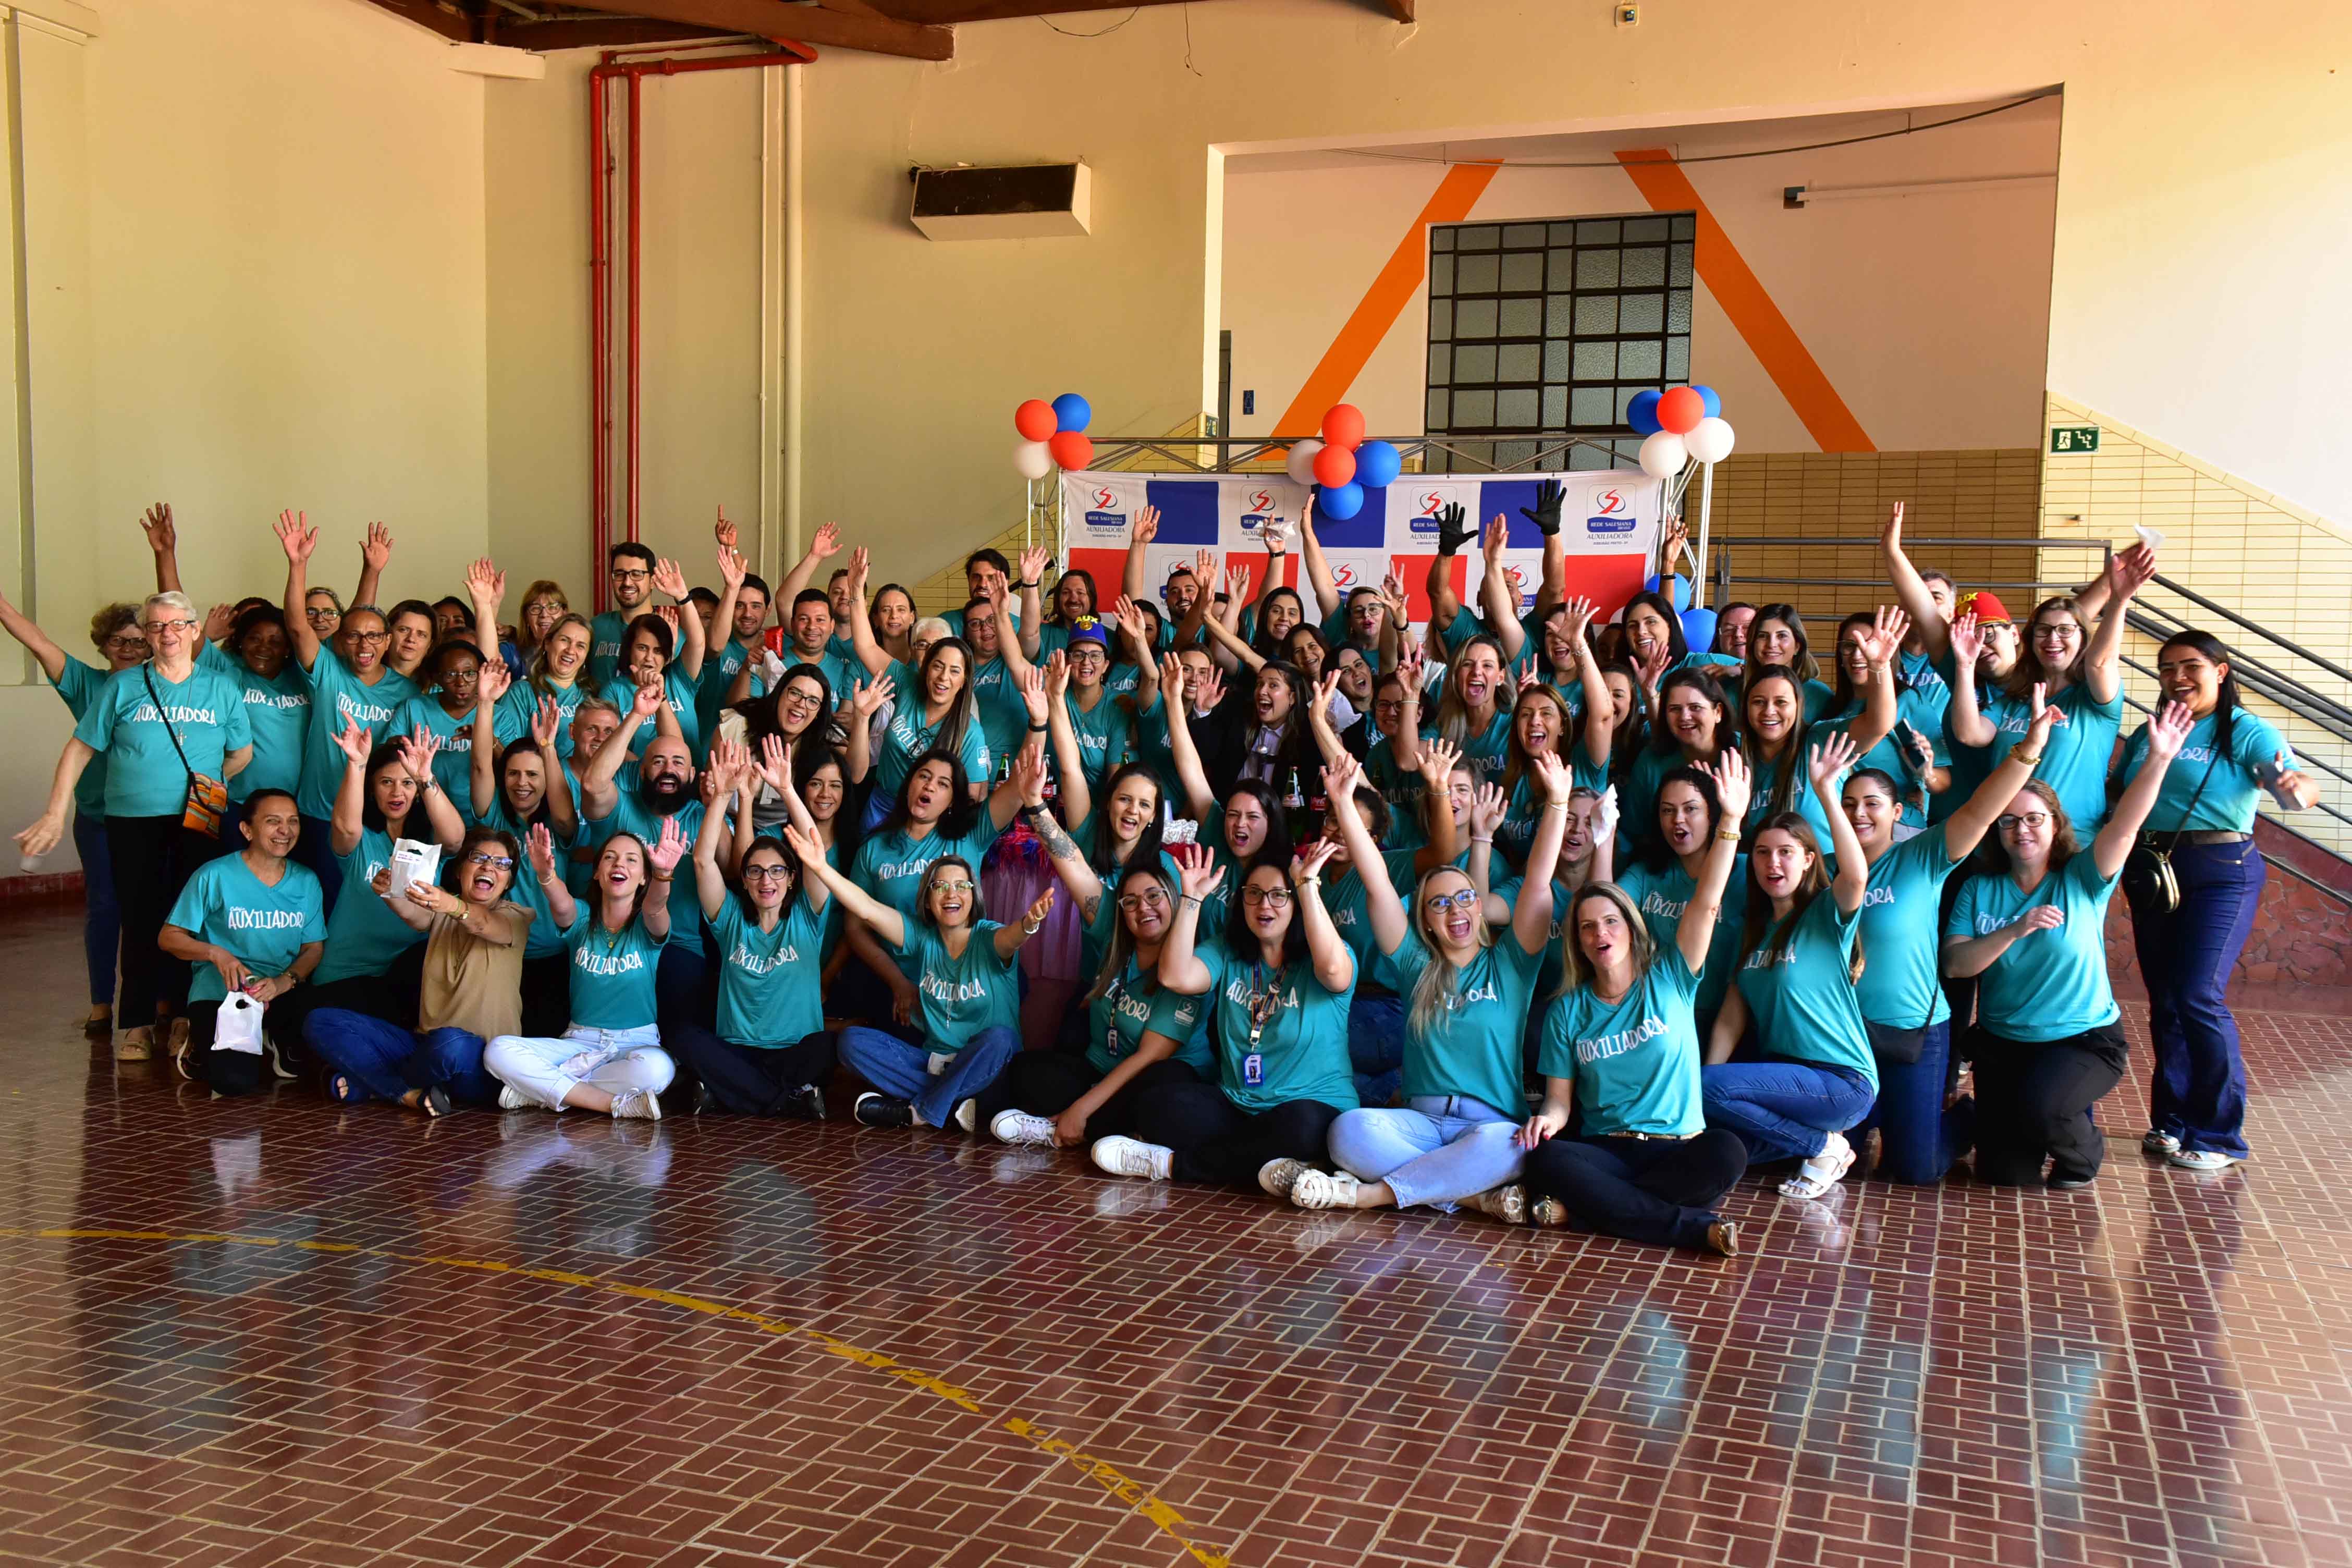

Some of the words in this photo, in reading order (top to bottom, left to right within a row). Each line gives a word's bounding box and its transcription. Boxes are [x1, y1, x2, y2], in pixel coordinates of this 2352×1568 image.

[1075, 615, 1098, 624] AUX
[133, 705, 217, 727] AUXILIADORA
[1576, 1014, 1670, 1065] AUXILIADORA
